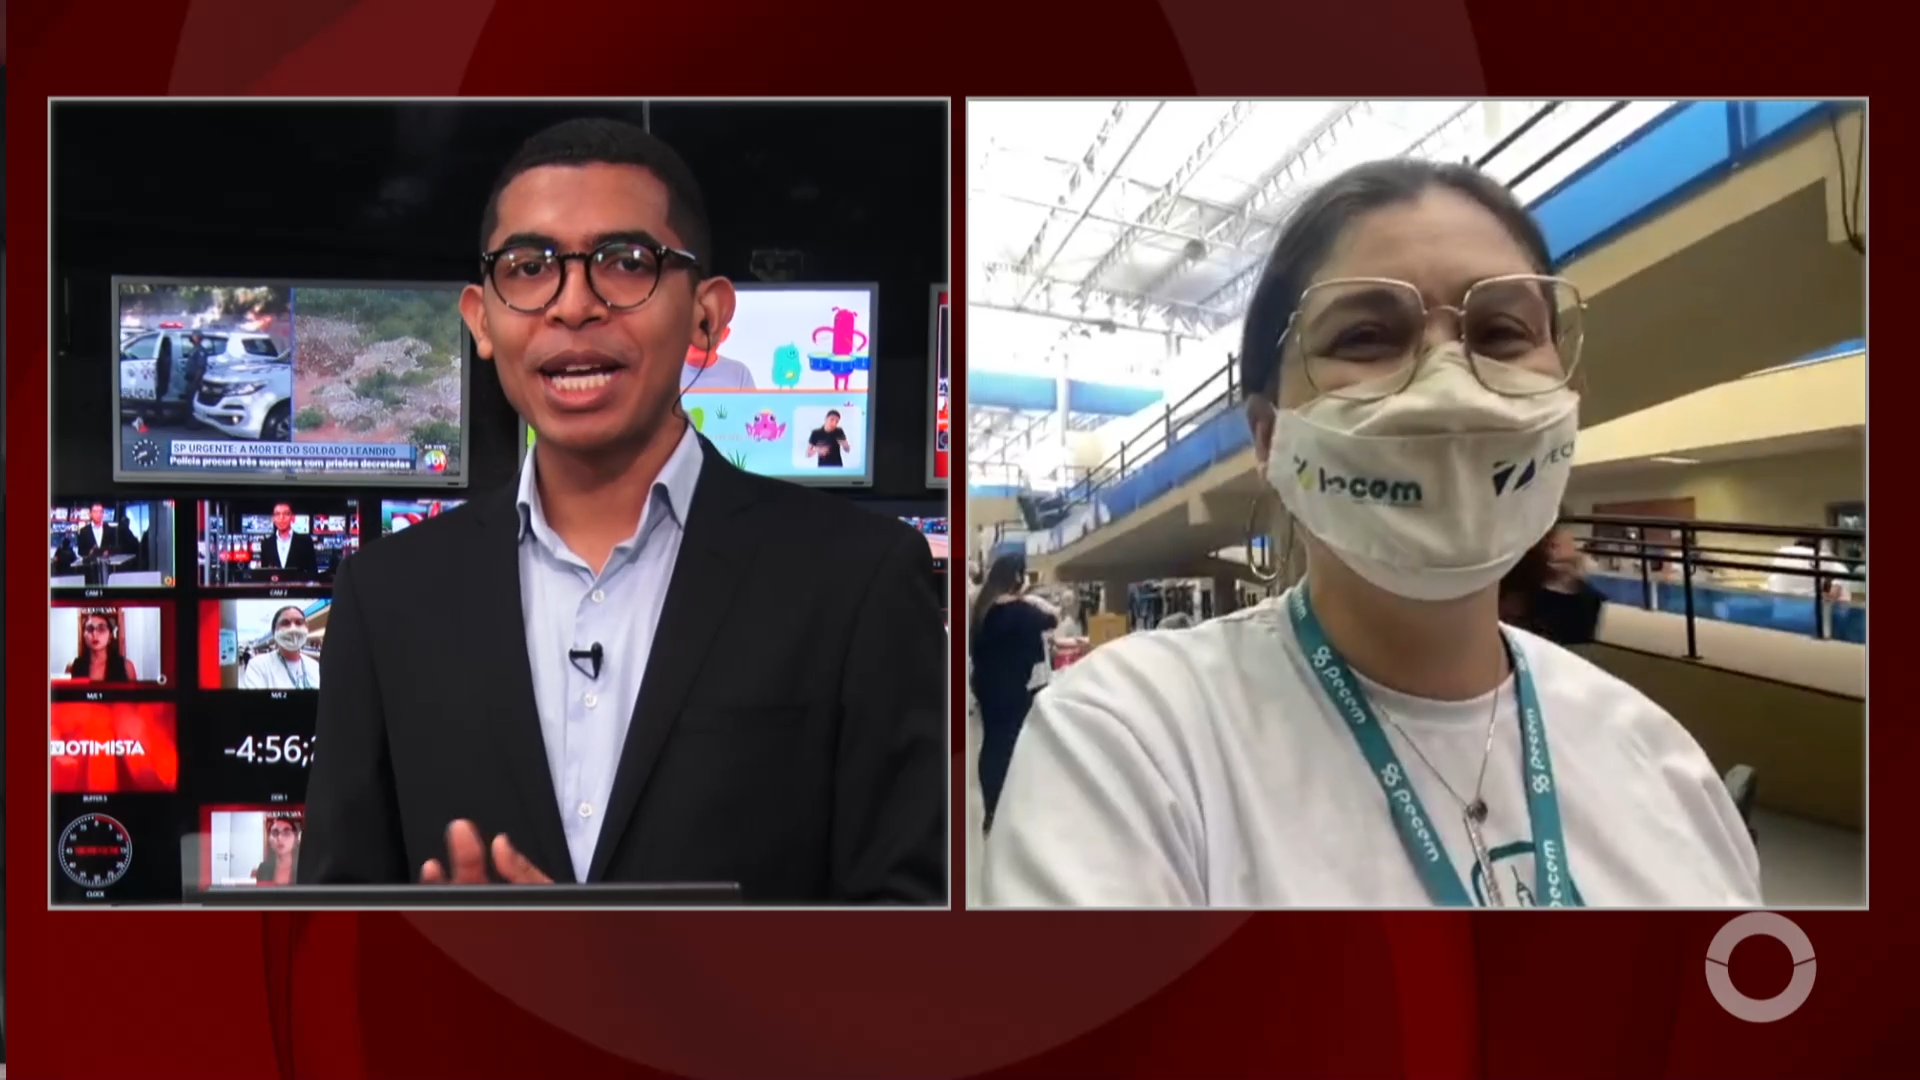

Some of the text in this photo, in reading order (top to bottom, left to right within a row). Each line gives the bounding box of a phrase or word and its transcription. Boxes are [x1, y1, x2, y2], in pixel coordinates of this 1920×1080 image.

[173, 443, 396, 457] SP URGENTE: A MORTE DO SOLDADO LEANDRO
[203, 458, 237, 468] procura
[259, 458, 302, 469] suspeitos
[304, 460, 324, 468] com
[360, 459, 410, 470] decretadas
[1324, 665, 1366, 725] pecem
[66, 740, 145, 756] OTIMISTA
[1527, 708, 1545, 770] pecem
[1394, 788, 1440, 862] pecem
